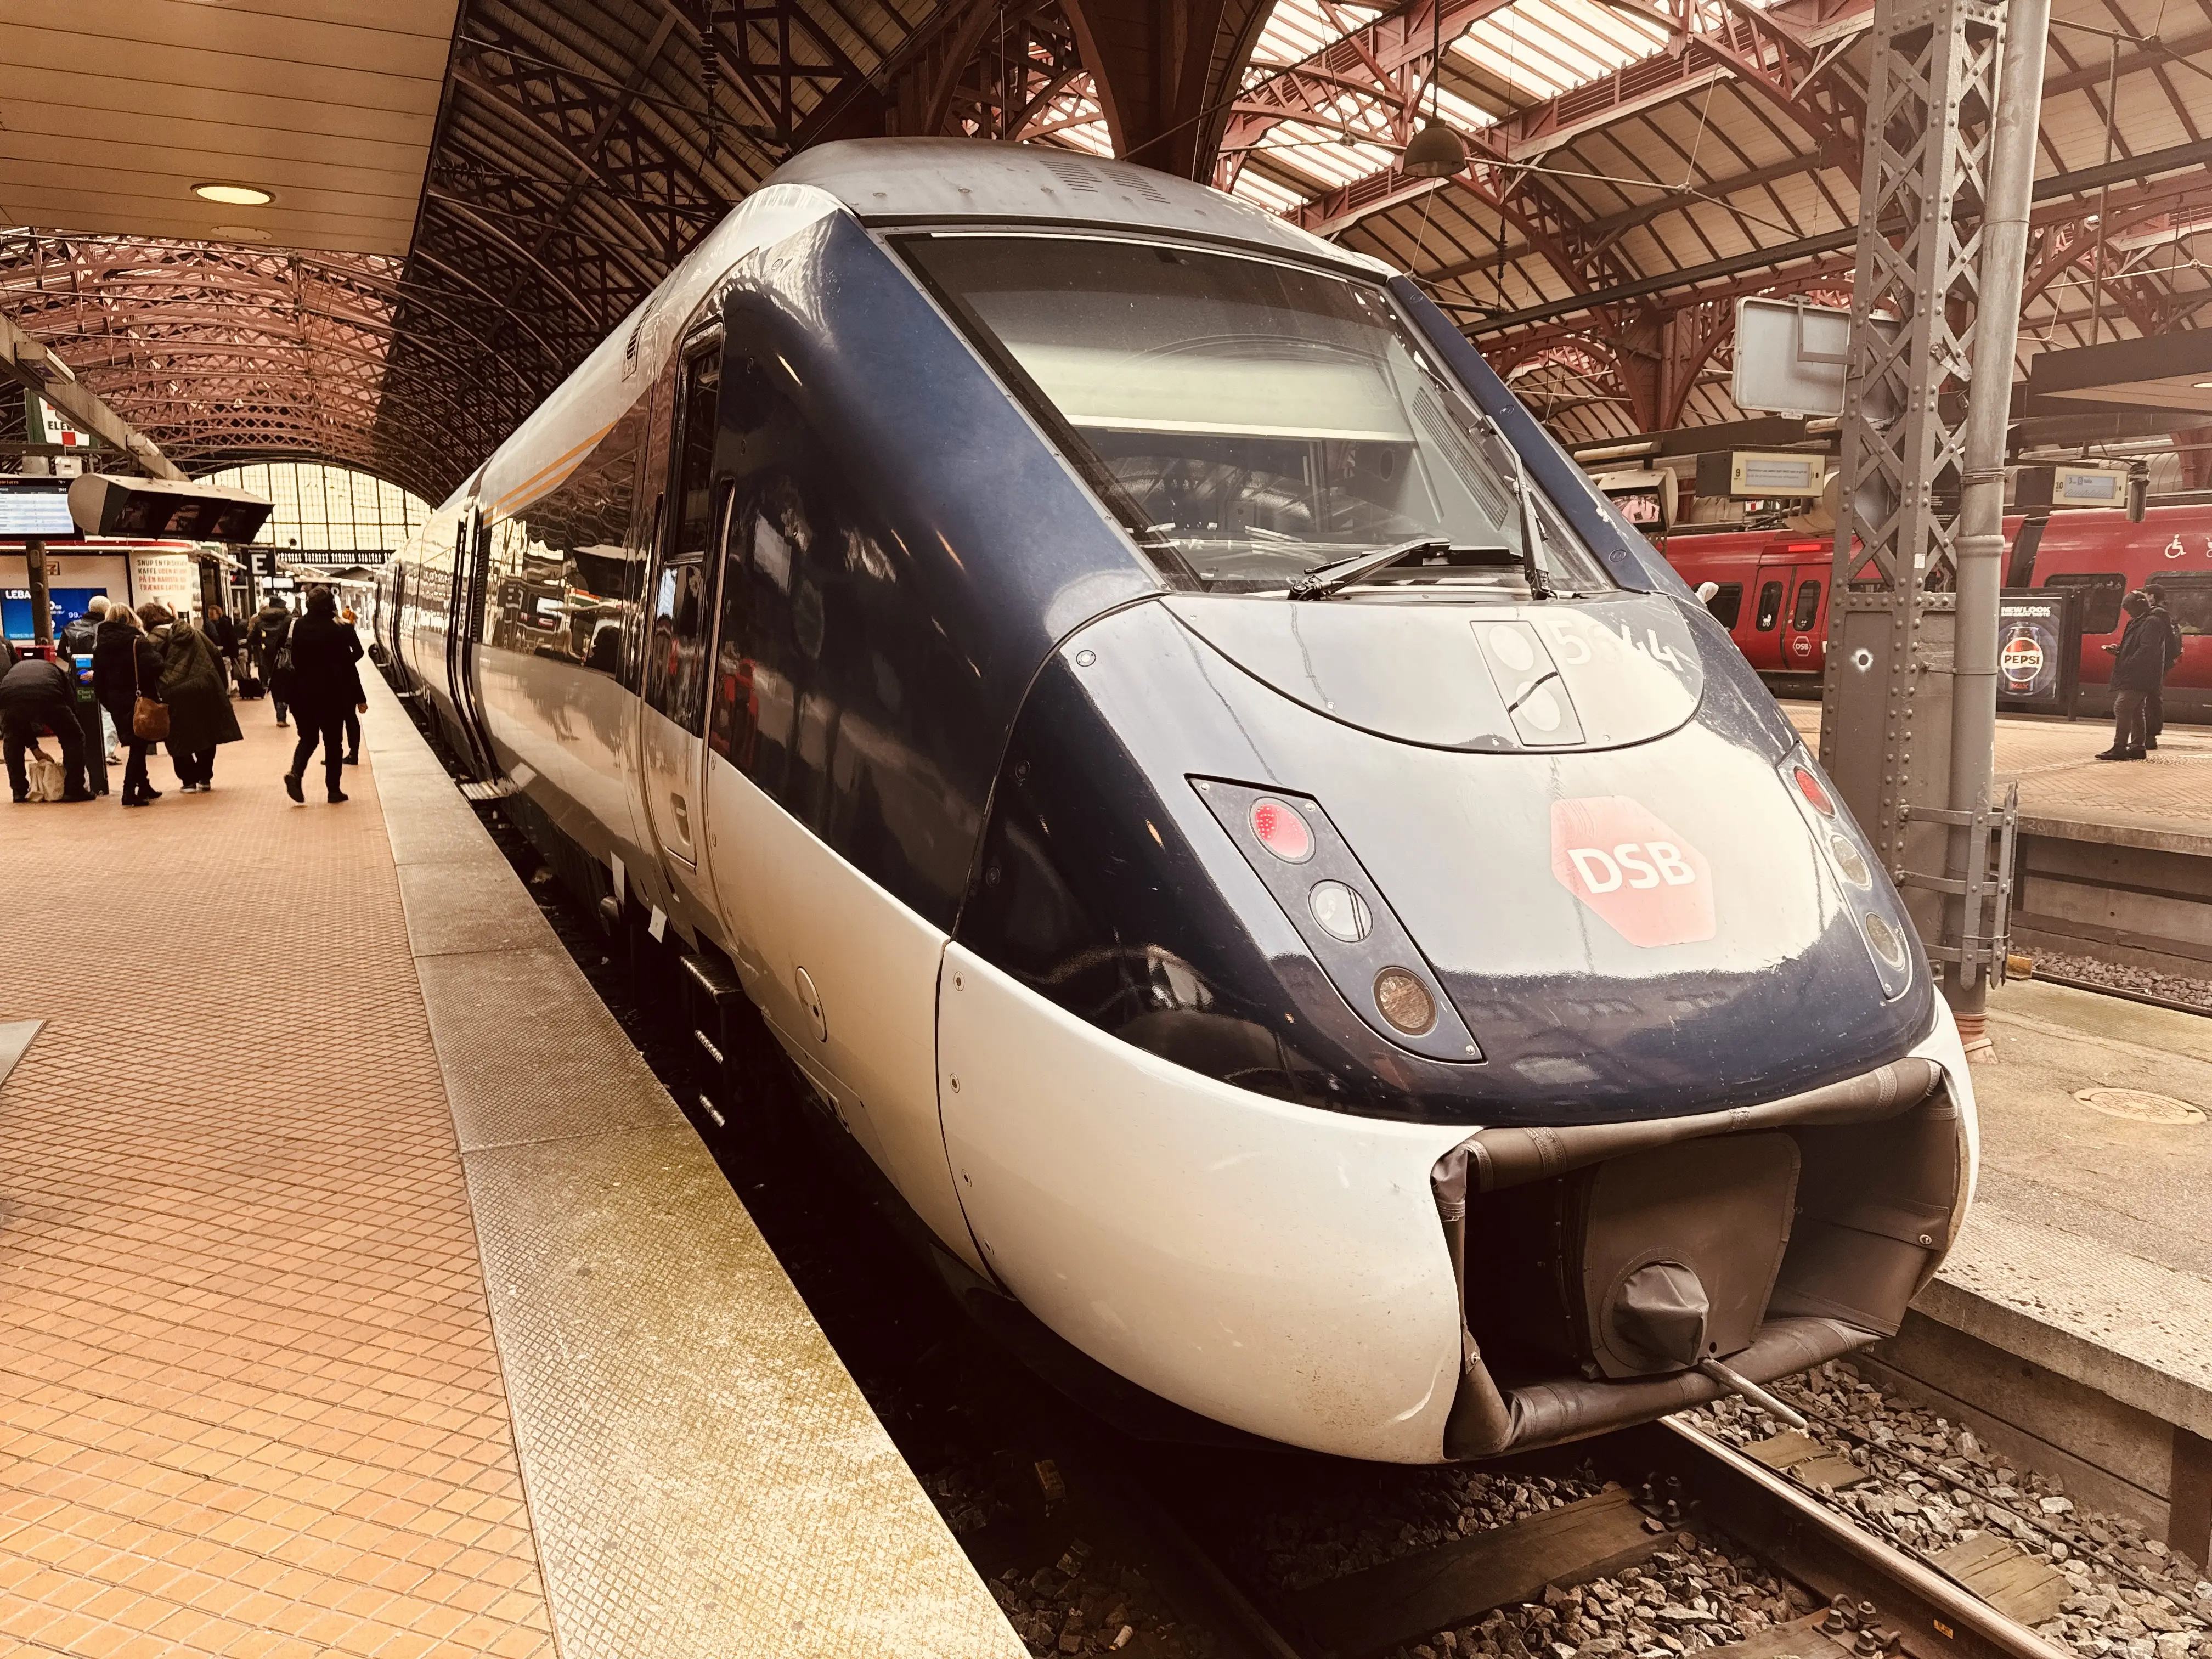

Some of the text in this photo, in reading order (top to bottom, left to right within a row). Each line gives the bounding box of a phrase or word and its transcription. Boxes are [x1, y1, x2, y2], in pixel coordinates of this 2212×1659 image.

[1736, 469, 1741, 477] 9
[251, 554, 268, 574] E
[5, 590, 31, 599] LEBA
[2004, 655, 2040, 664] PEPSI
[1567, 841, 1696, 894] DSB
